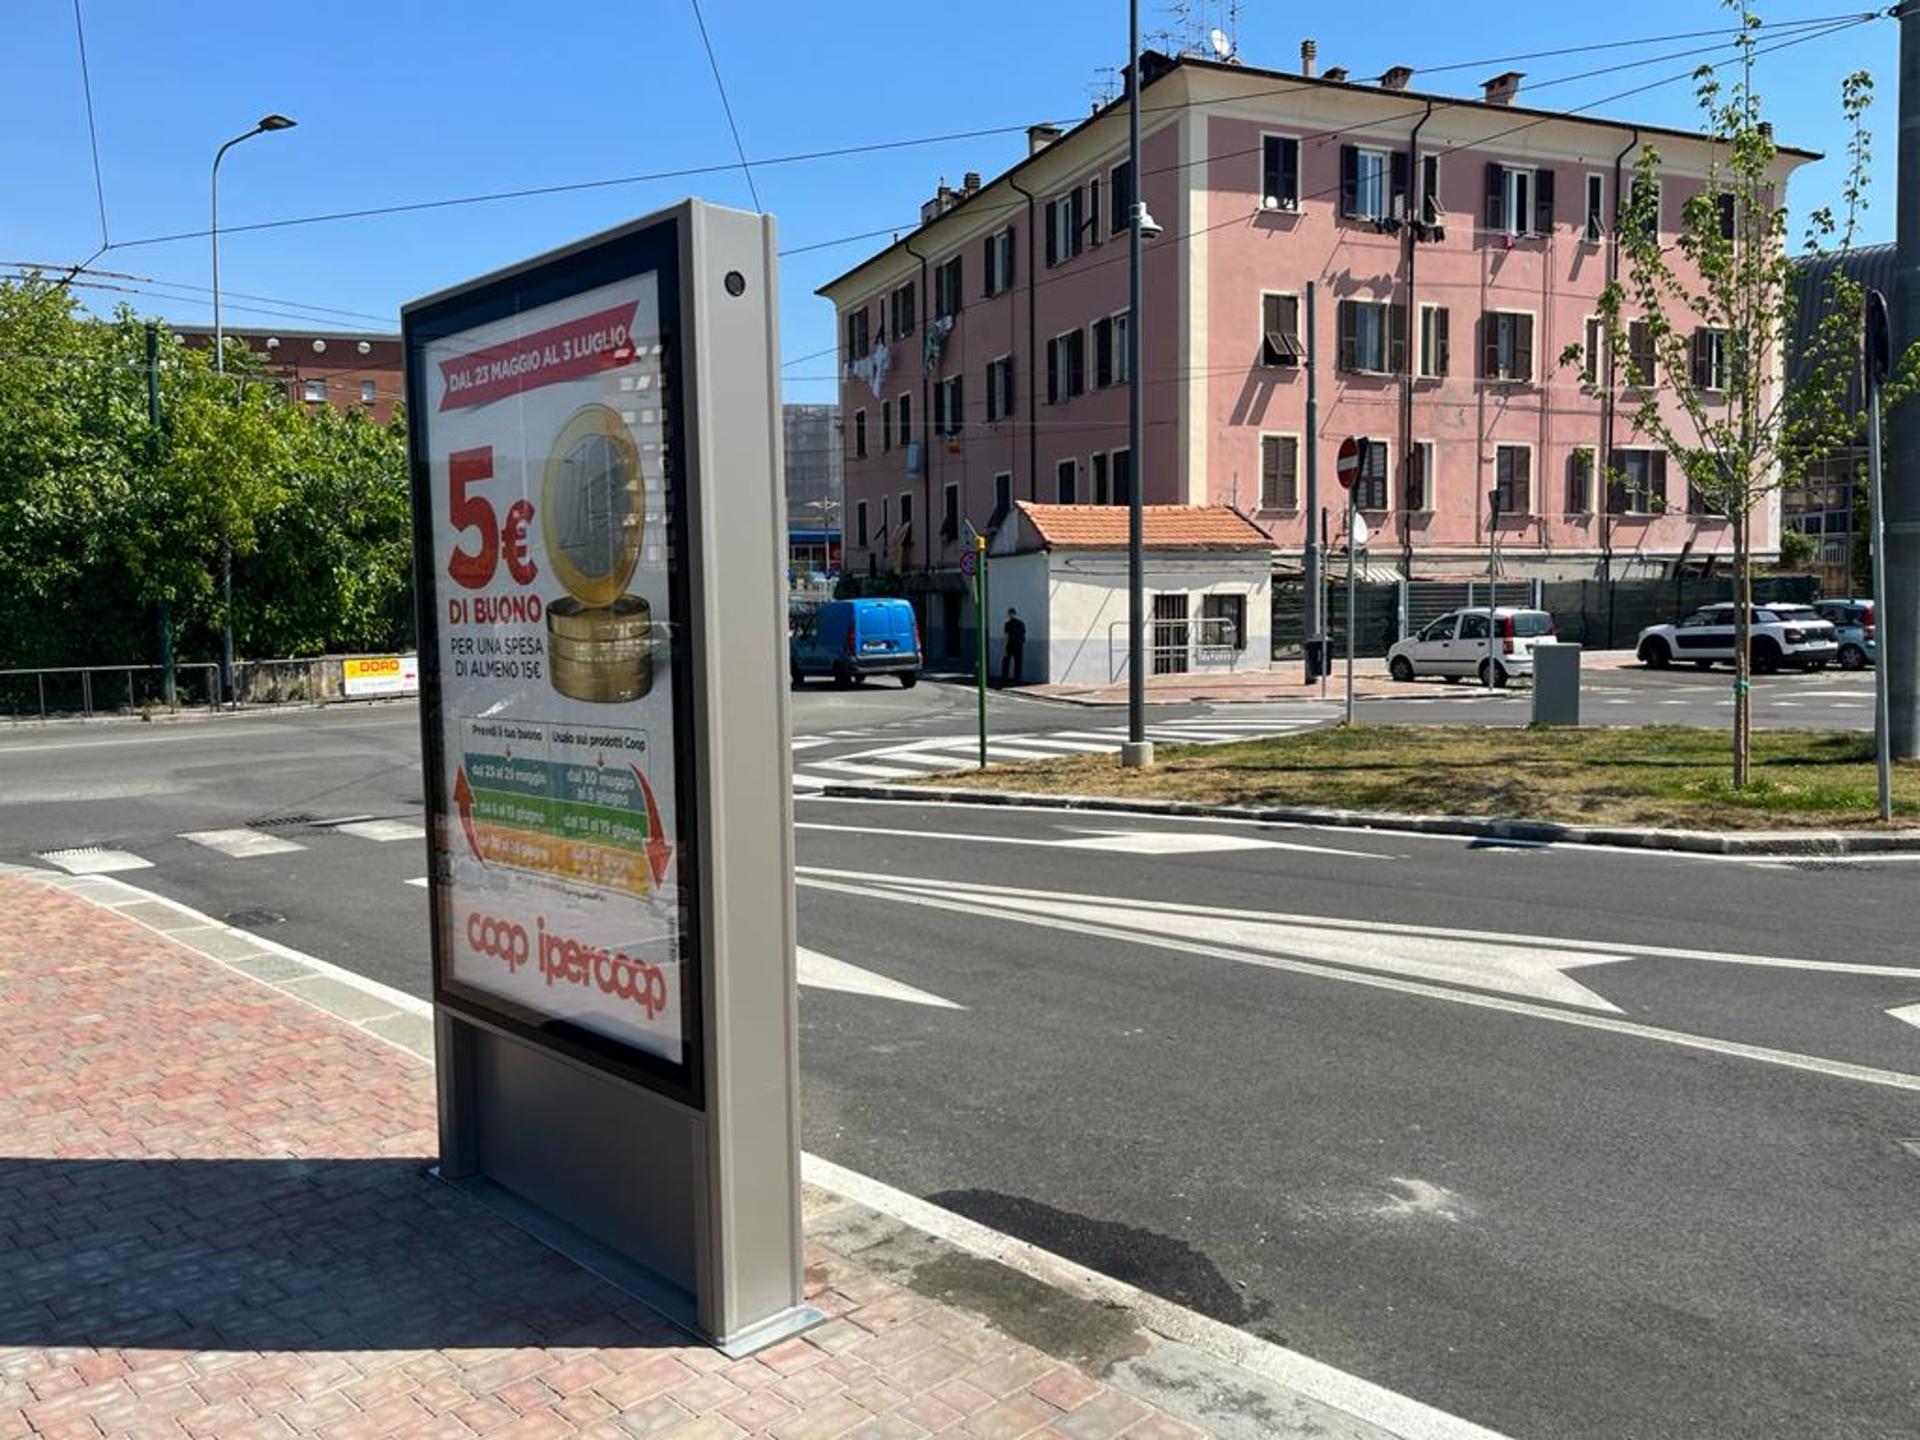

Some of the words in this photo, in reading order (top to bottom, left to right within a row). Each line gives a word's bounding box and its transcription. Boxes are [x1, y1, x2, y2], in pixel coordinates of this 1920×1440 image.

[450, 371, 474, 391] DAL
[475, 364, 491, 384] 23
[491, 350, 540, 379] MAGGIO
[543, 346, 560, 366] AL
[563, 342, 572, 360] 3
[573, 324, 626, 358] LUGLIO
[449, 599, 468, 625] DI
[474, 595, 542, 625] BUONO
[451, 637, 473, 655] PER
[477, 638, 501, 656] UNA
[504, 638, 544, 656] SPESA
[455, 660, 468, 677] DI
[471, 661, 519, 679] ALMENO
[521, 662, 542, 679] 15€
[624, 736, 646, 753] Coop
[468, 912, 529, 974] coop
[537, 915, 667, 1020] ipercoop
